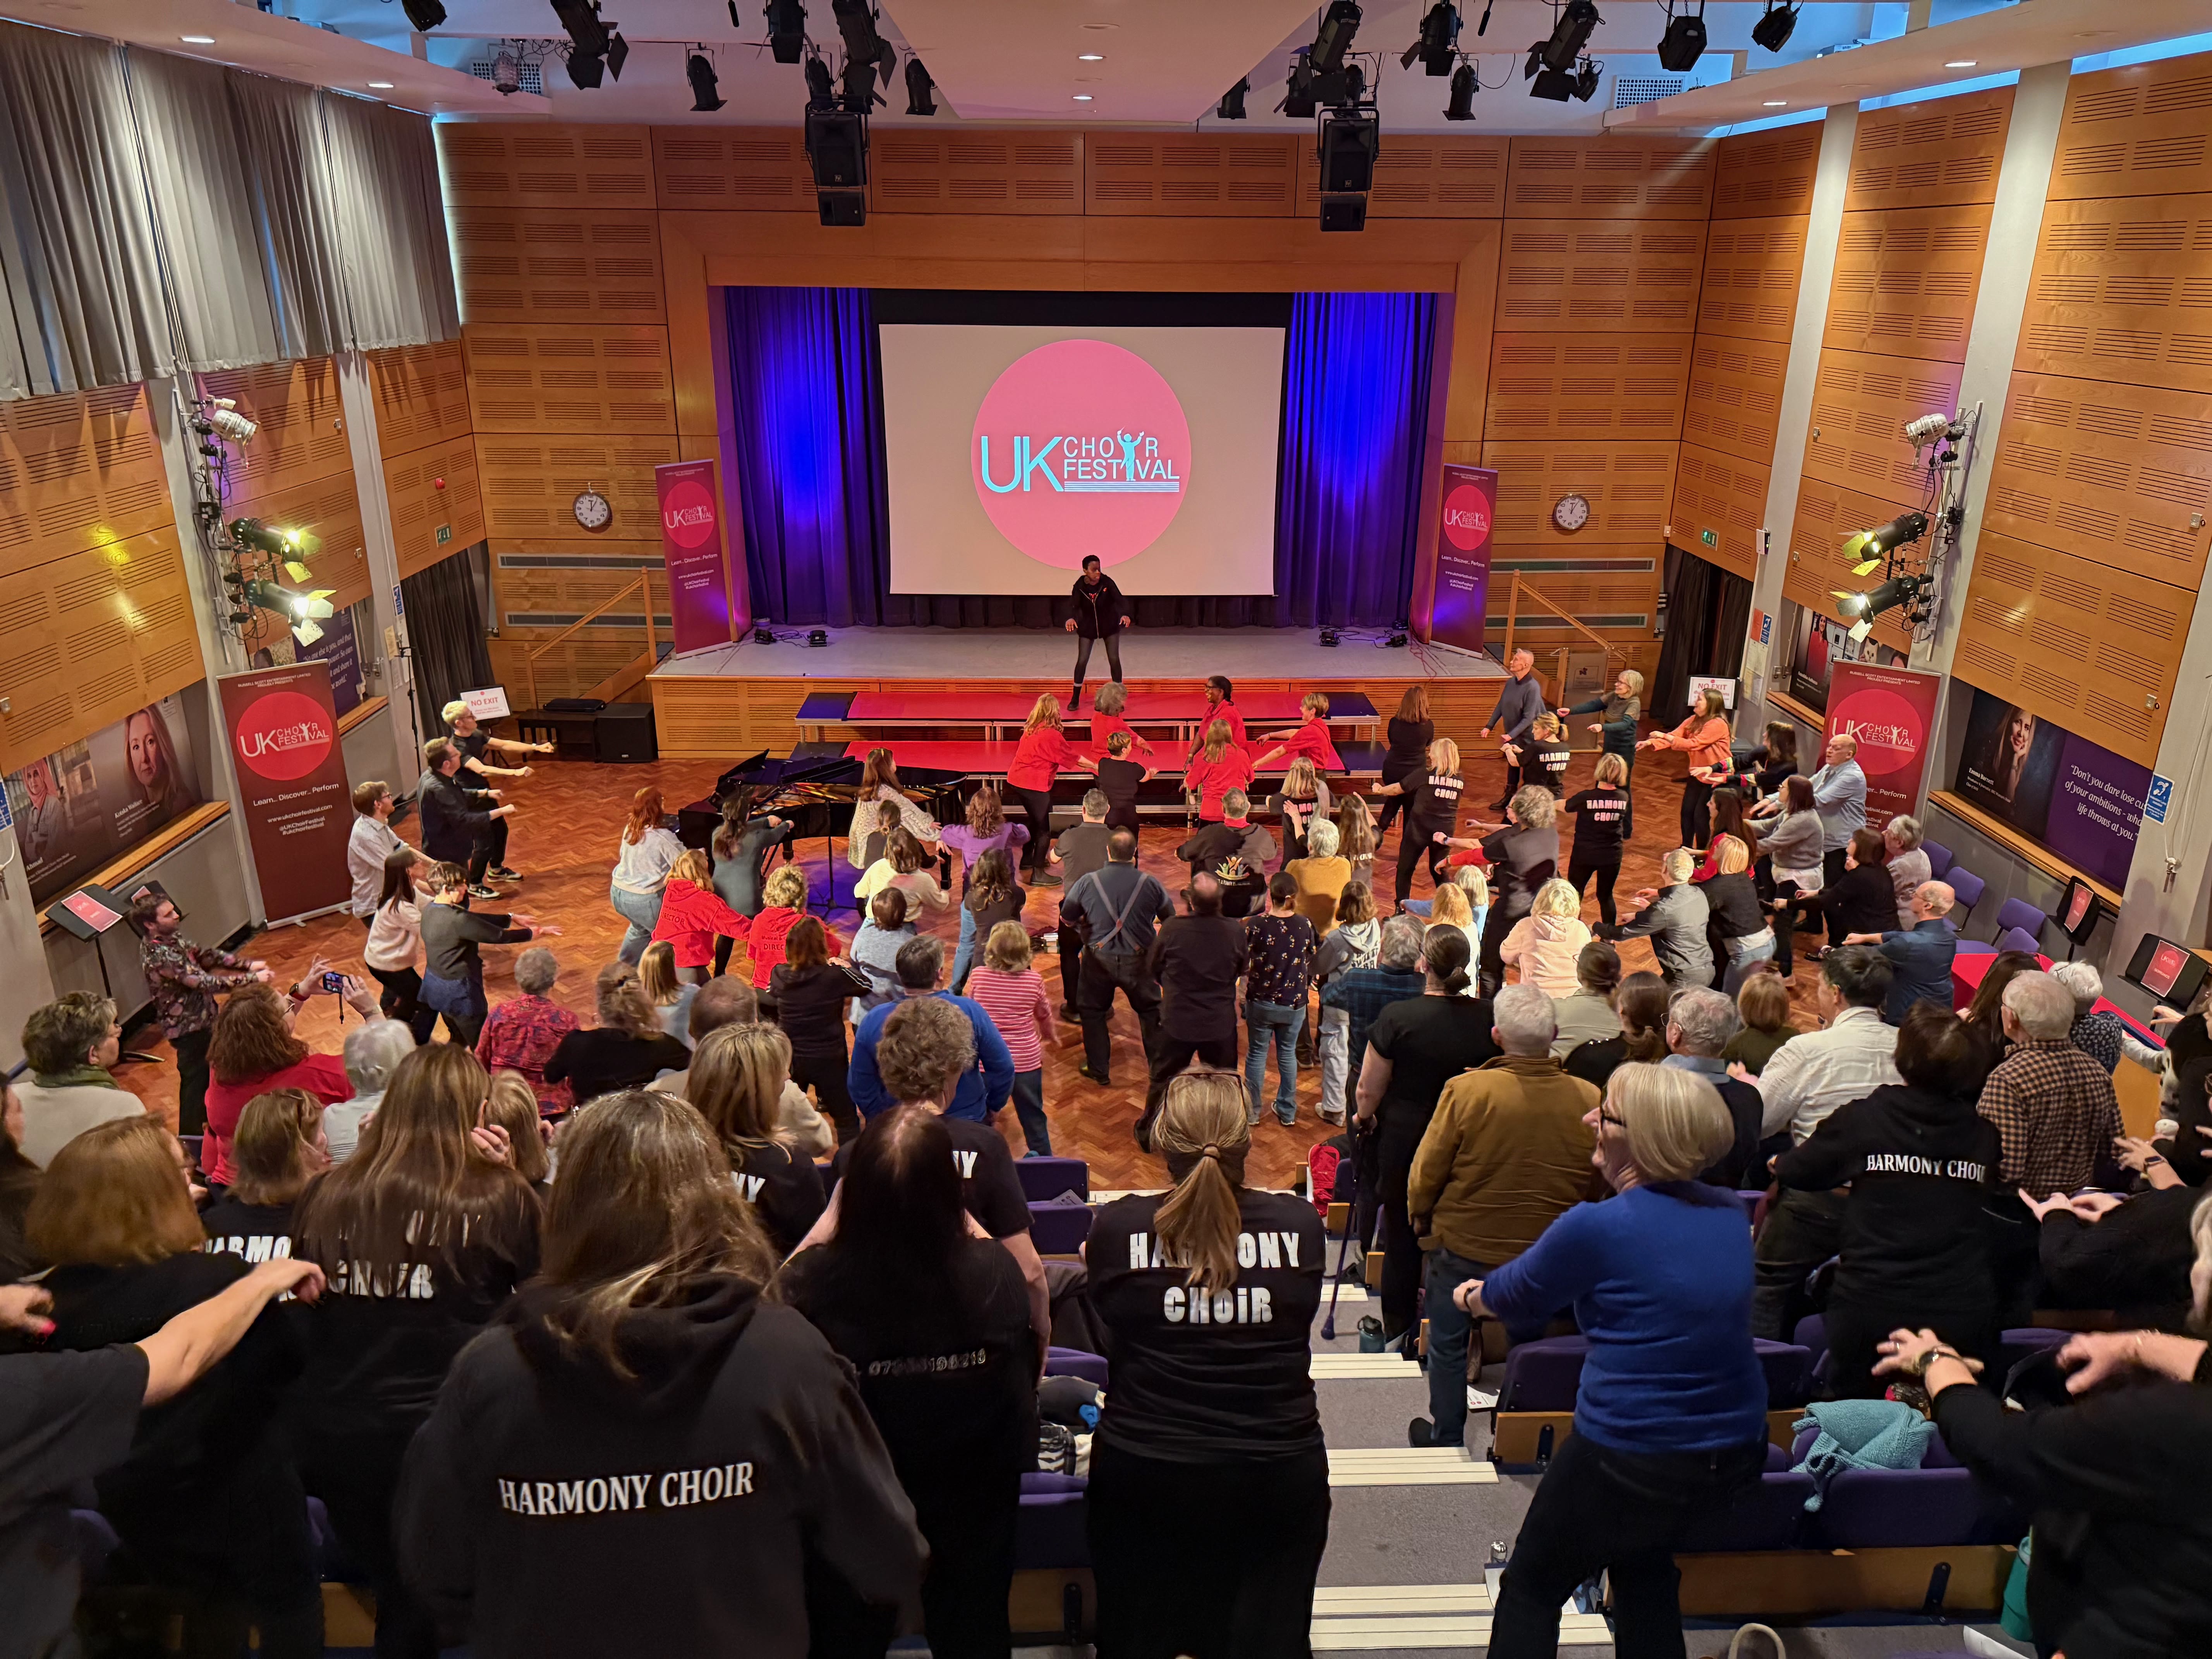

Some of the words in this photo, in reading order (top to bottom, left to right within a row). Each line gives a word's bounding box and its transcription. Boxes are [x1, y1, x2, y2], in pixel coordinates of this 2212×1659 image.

[981, 435, 1064, 493] UK
[665, 509, 687, 528] UK
[1445, 508, 1463, 527] UK
[1832, 717, 1868, 743] UK
[240, 730, 280, 757] UK
[312, 783, 339, 793] Perform
[1879, 788, 1906, 799] Perform
[2065, 781, 2074, 791] of
[2071, 785, 2088, 797] your
[2088, 793, 2122, 816] ambitions
[2089, 776, 2104, 789] you
[2104, 783, 2120, 797] dare
[2121, 790, 2135, 804] lose
[1587, 800, 1626, 810] HARMONY
[2077, 802, 2087, 815] life
[2088, 809, 2111, 828] throws
[2111, 823, 2119, 833] at
[1865, 1154, 1942, 1176] HARMONY
[498, 1474, 653, 1515] HARMONY
[659, 1461, 755, 1508] CHOIR
